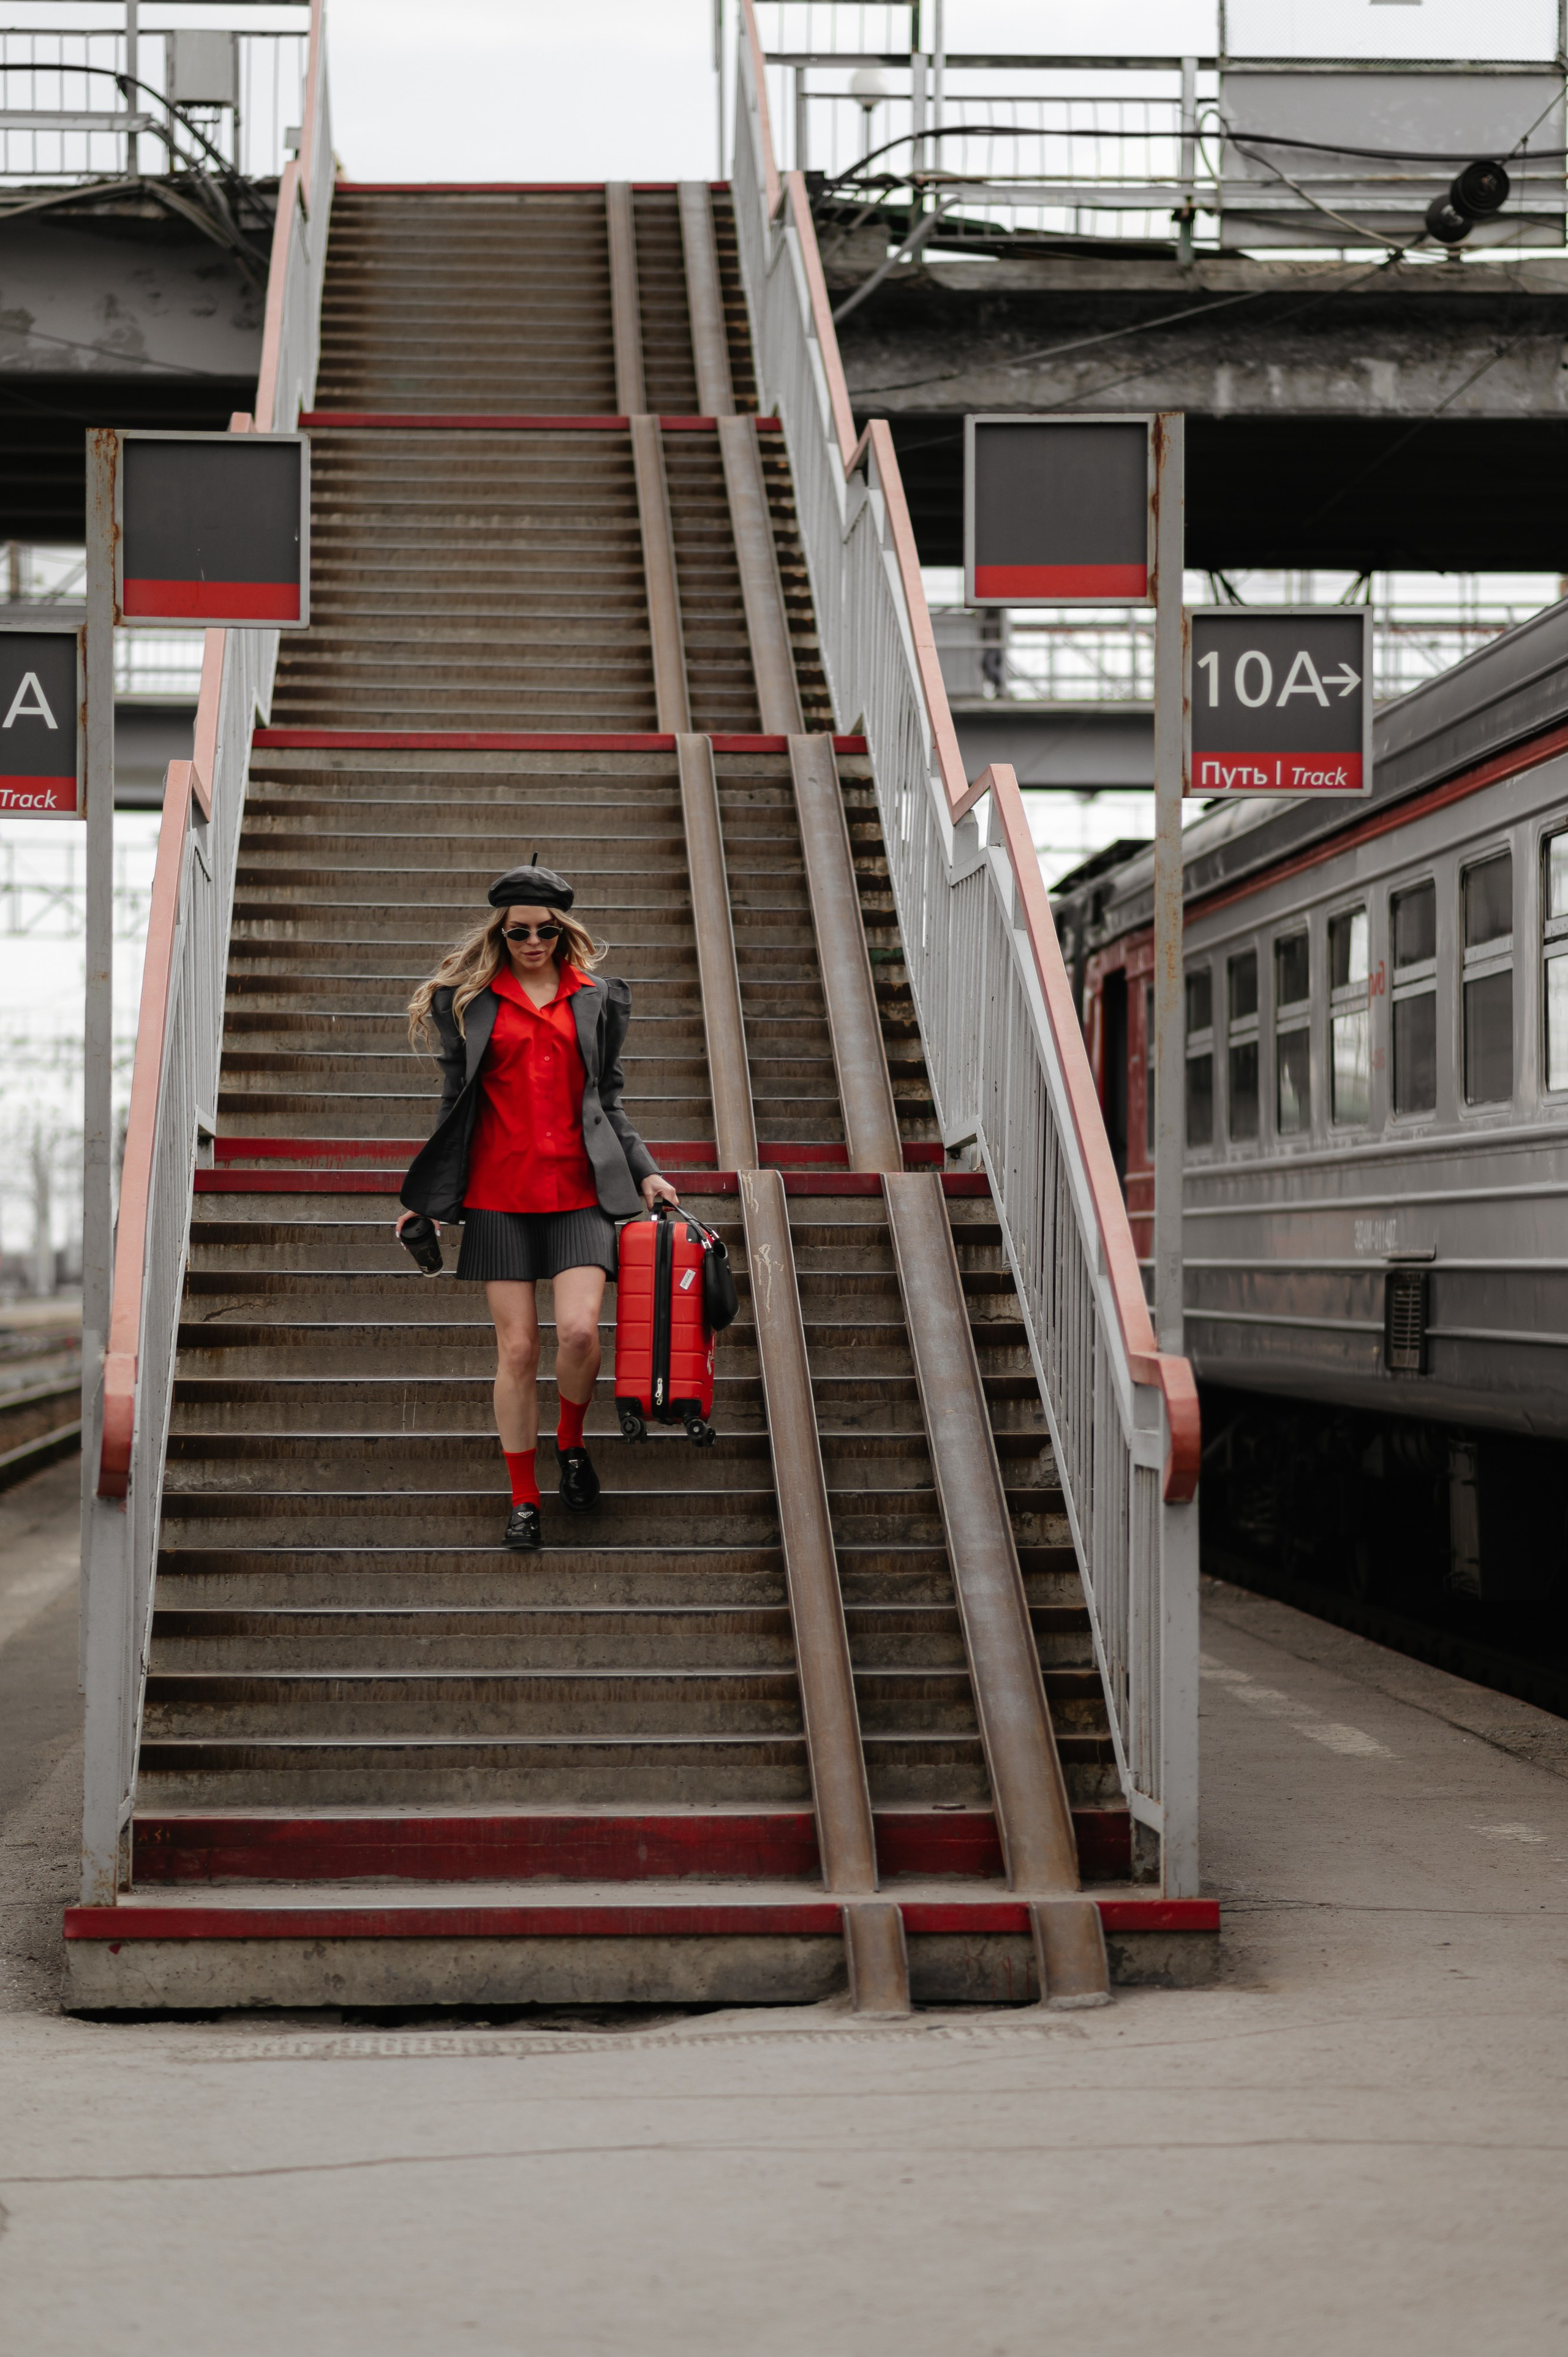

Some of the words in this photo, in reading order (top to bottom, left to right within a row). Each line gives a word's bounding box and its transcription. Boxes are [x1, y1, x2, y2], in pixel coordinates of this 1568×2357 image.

[1197, 651, 1330, 707] 10A
[2, 672, 58, 729] A
[1202, 761, 1267, 789] Путь
[1292, 767, 1348, 786] Track
[0, 790, 58, 808] Track
